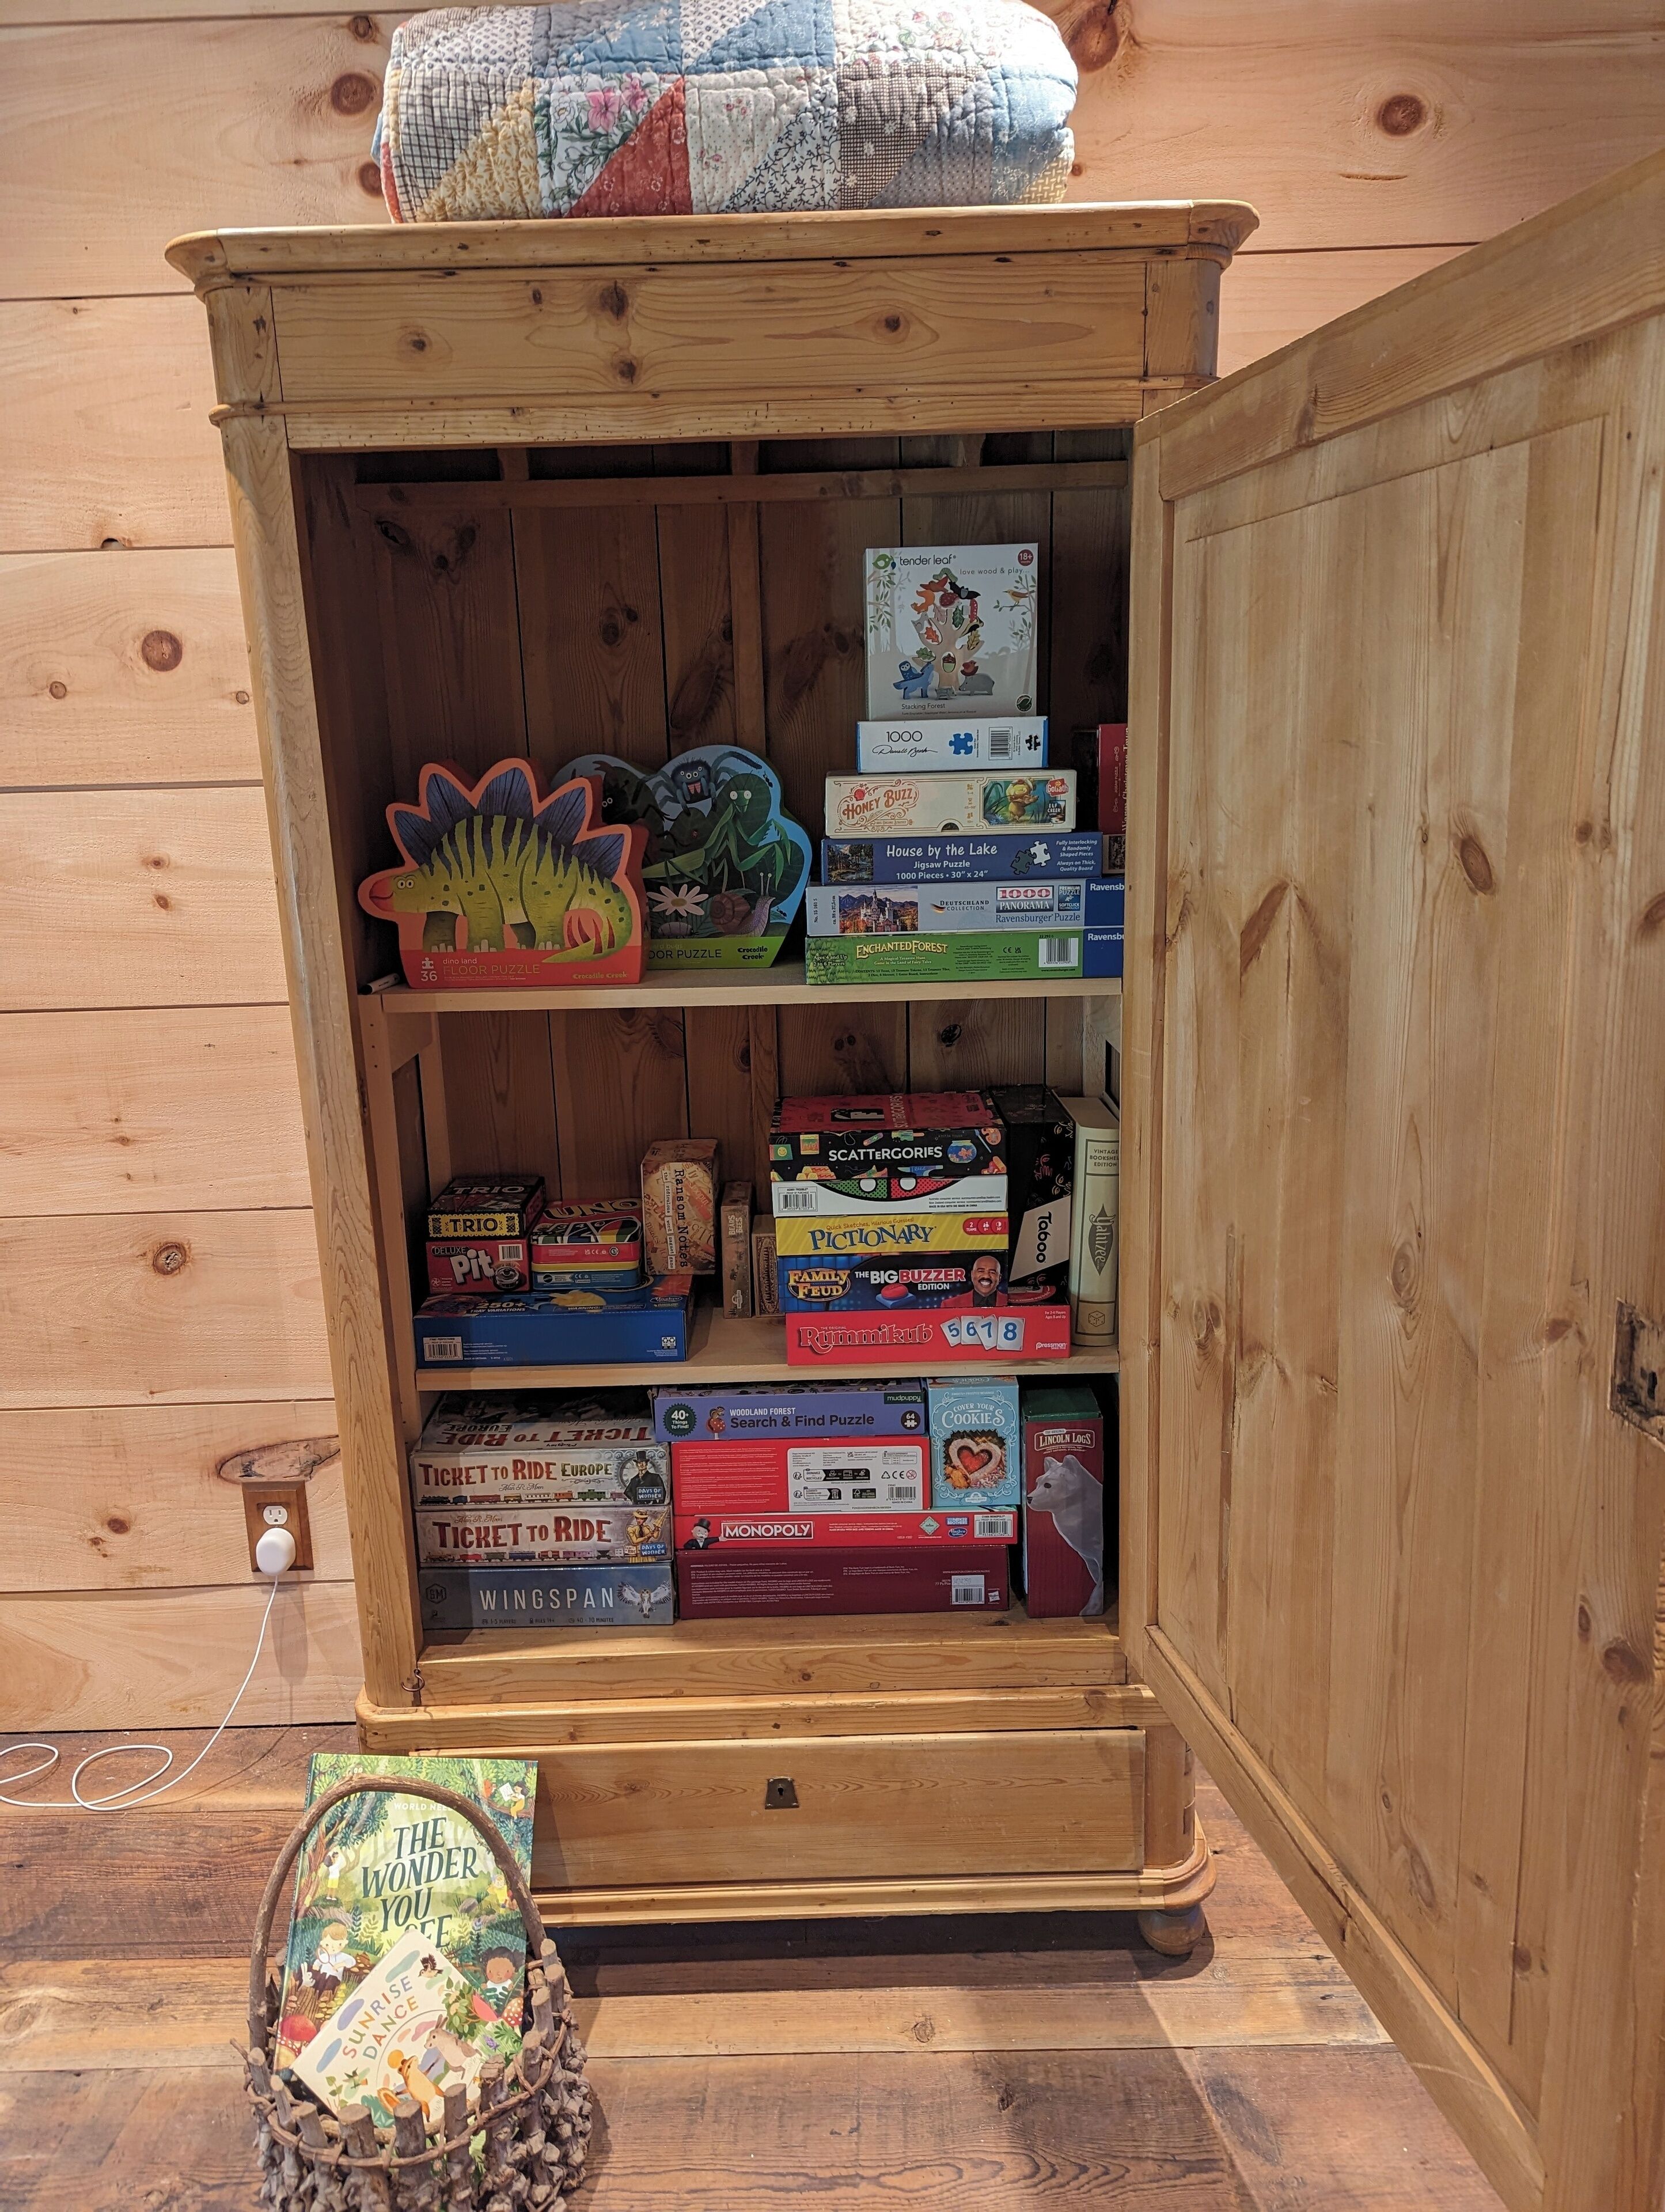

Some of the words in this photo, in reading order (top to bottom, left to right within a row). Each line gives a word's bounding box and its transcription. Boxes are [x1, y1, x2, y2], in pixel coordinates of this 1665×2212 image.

[900, 555, 932, 566] tender
[933, 554, 952, 565] leaf
[901, 703, 926, 711] Stacking
[886, 730, 923, 743] 1000
[1047, 785, 1068, 794] Goliath
[842, 796, 881, 820] HONEY
[883, 788, 913, 809] BUZZ
[886, 844, 923, 857] House
[927, 843, 941, 859] by
[946, 843, 965, 856] the
[969, 842, 998, 855] Lake
[913, 861, 942, 870] Jigsaw
[943, 859, 970, 868] Puzzle
[999, 888, 1050, 899] 1000
[999, 901, 1050, 910] PANORAMA
[995, 914, 1052, 924] Ravensburger
[1054, 912, 1080, 922] Puzzle
[677, 949, 722, 959] PUZZLE
[420, 971, 438, 982] 36
[443, 965, 487, 975] FLOOR
[491, 964, 540, 975] PUZZLE
[828, 1146, 942, 1161] SCATTERGORIES
[453, 1186, 524, 1194] TRIO
[674, 1169, 687, 1220] Ransom
[543, 1198, 642, 1220] UNO
[449, 1218, 498, 1232] TRIO
[843, 1221, 870, 1229] Sketches,
[807, 1224, 934, 1251] PICTIONARY
[1036, 1211, 1052, 1263] Taboo
[1088, 1214, 1116, 1263] Yahtzee
[677, 1226, 690, 1268] Notes
[788, 1270, 851, 1285] FAMILY
[855, 1271, 870, 1279] THE
[870, 1270, 898, 1284] BIG
[898, 1268, 966, 1283] BUZZER
[797, 1282, 843, 1299] FEUD
[917, 1283, 950, 1291] EDITION
[947, 1323, 960, 1338] 5
[966, 1321, 977, 1336] 6
[981, 1321, 992, 1339] 7
[1003, 1322, 1017, 1341] 8
[799, 1324, 933, 1354] Rummikub
[670, 1410, 689, 1420] 40+
[730, 1408, 768, 1416] WOODLAND
[770, 1407, 796, 1415] FOREST
[953, 1403, 974, 1412] COVER
[977, 1403, 995, 1411] YOUR
[730, 1416, 779, 1429] Search
[781, 1416, 790, 1427] &
[795, 1415, 825, 1426] Find
[829, 1414, 875, 1426] Puzzle
[942, 1409, 1005, 1428] COOKIES
[443, 1423, 515, 1433] EUROPE
[544, 1426, 652, 1442] TICKET
[438, 1431, 507, 1446] RIDE
[514, 1433, 537, 1442] TO
[1039, 1434, 1070, 1448] LINCOLN
[1072, 1433, 1091, 1445] LOGS
[418, 1462, 488, 1486] TICKET
[491, 1467, 509, 1480] TO
[512, 1459, 557, 1480] RIDE
[560, 1462, 612, 1477] EUROPE
[499, 1483, 515, 1491] Alan
[432, 1521, 522, 1548] TICKET
[526, 1525, 549, 1542] TO
[553, 1515, 612, 1543] RIDE
[726, 1524, 811, 1537] MONOPOLY
[479, 1588, 614, 1611] WINGSPAN
[394, 1803, 427, 1811] WORLD
[393, 1817, 447, 1860] THE
[362, 1847, 479, 1899] WONDER
[380, 1887, 434, 1933] YOU
[342, 1975, 413, 2059] SUNRISE
[362, 1995, 419, 2060] DANCE
